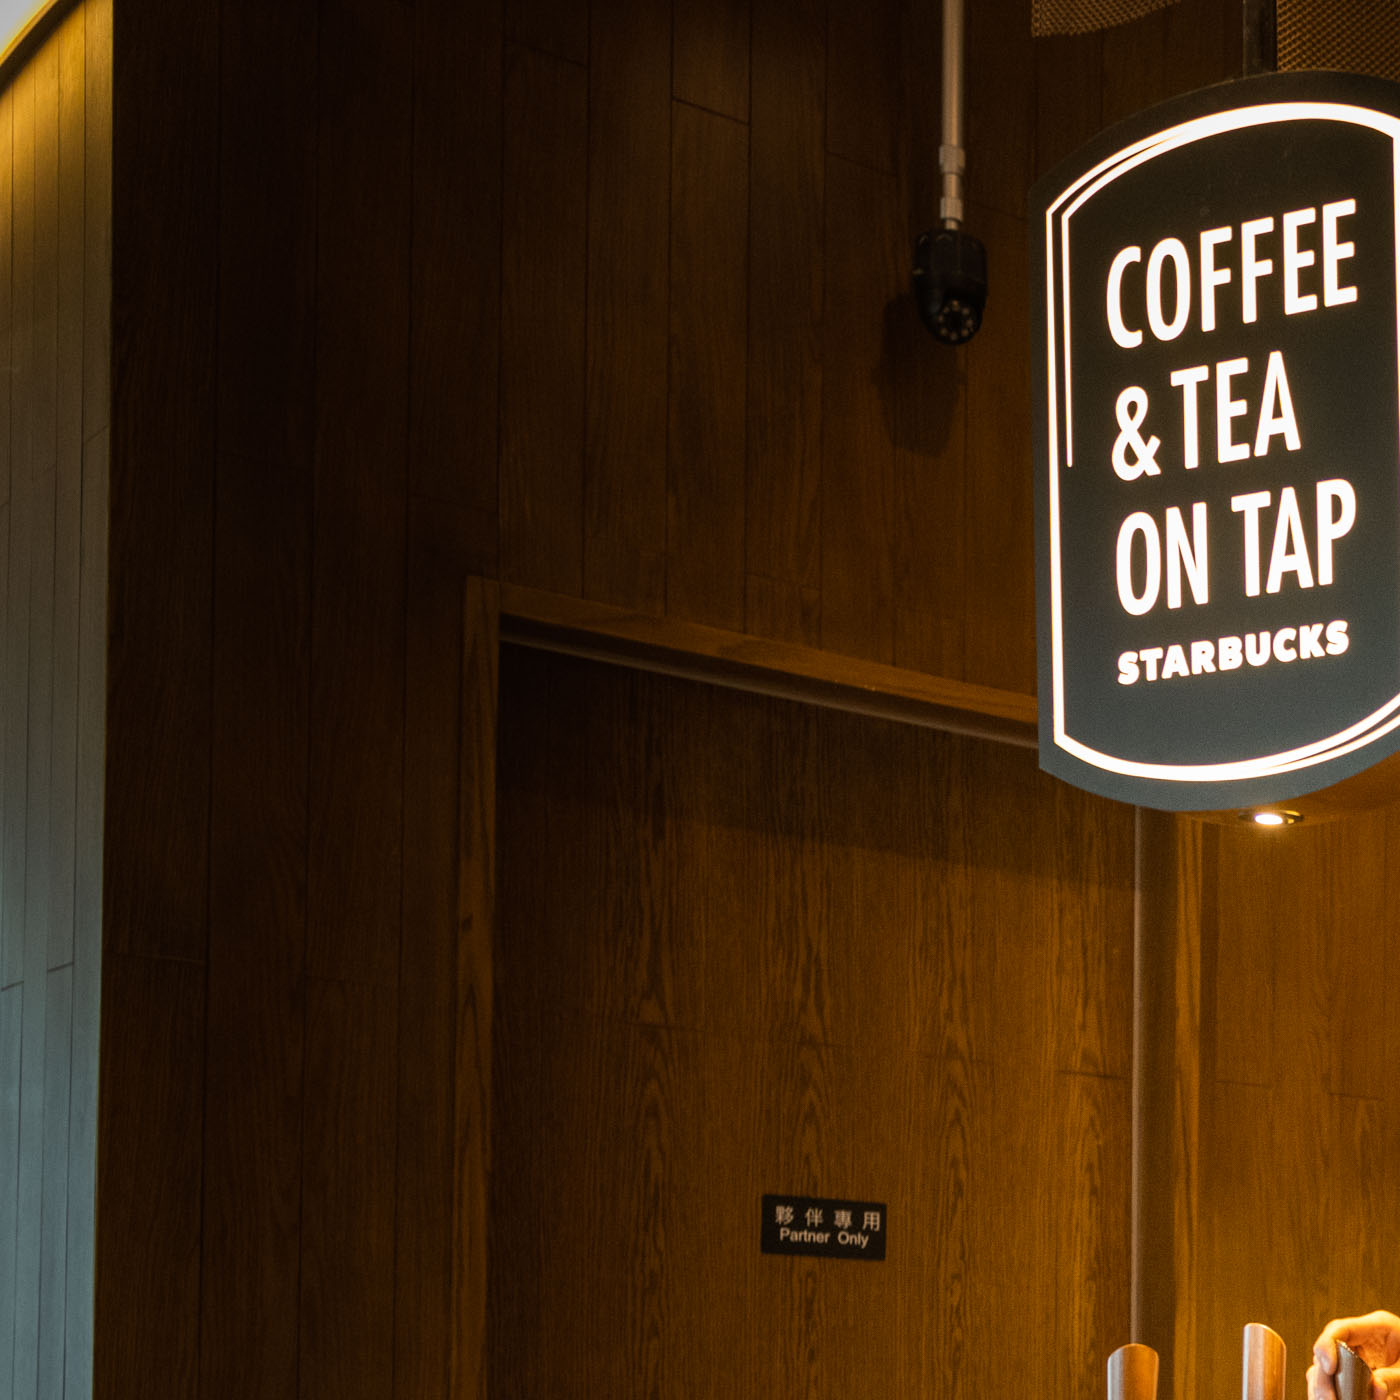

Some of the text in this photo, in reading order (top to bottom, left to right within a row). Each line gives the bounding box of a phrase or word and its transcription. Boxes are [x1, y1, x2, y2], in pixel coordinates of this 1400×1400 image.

[1105, 198, 1358, 348] COFFEE
[1111, 351, 1301, 481] & TEA
[1115, 478, 1357, 616] ON TAP
[1117, 619, 1349, 685] STARBUCKS
[775, 1205, 881, 1232] 夥伴專用
[779, 1227, 869, 1249] Partner Only
